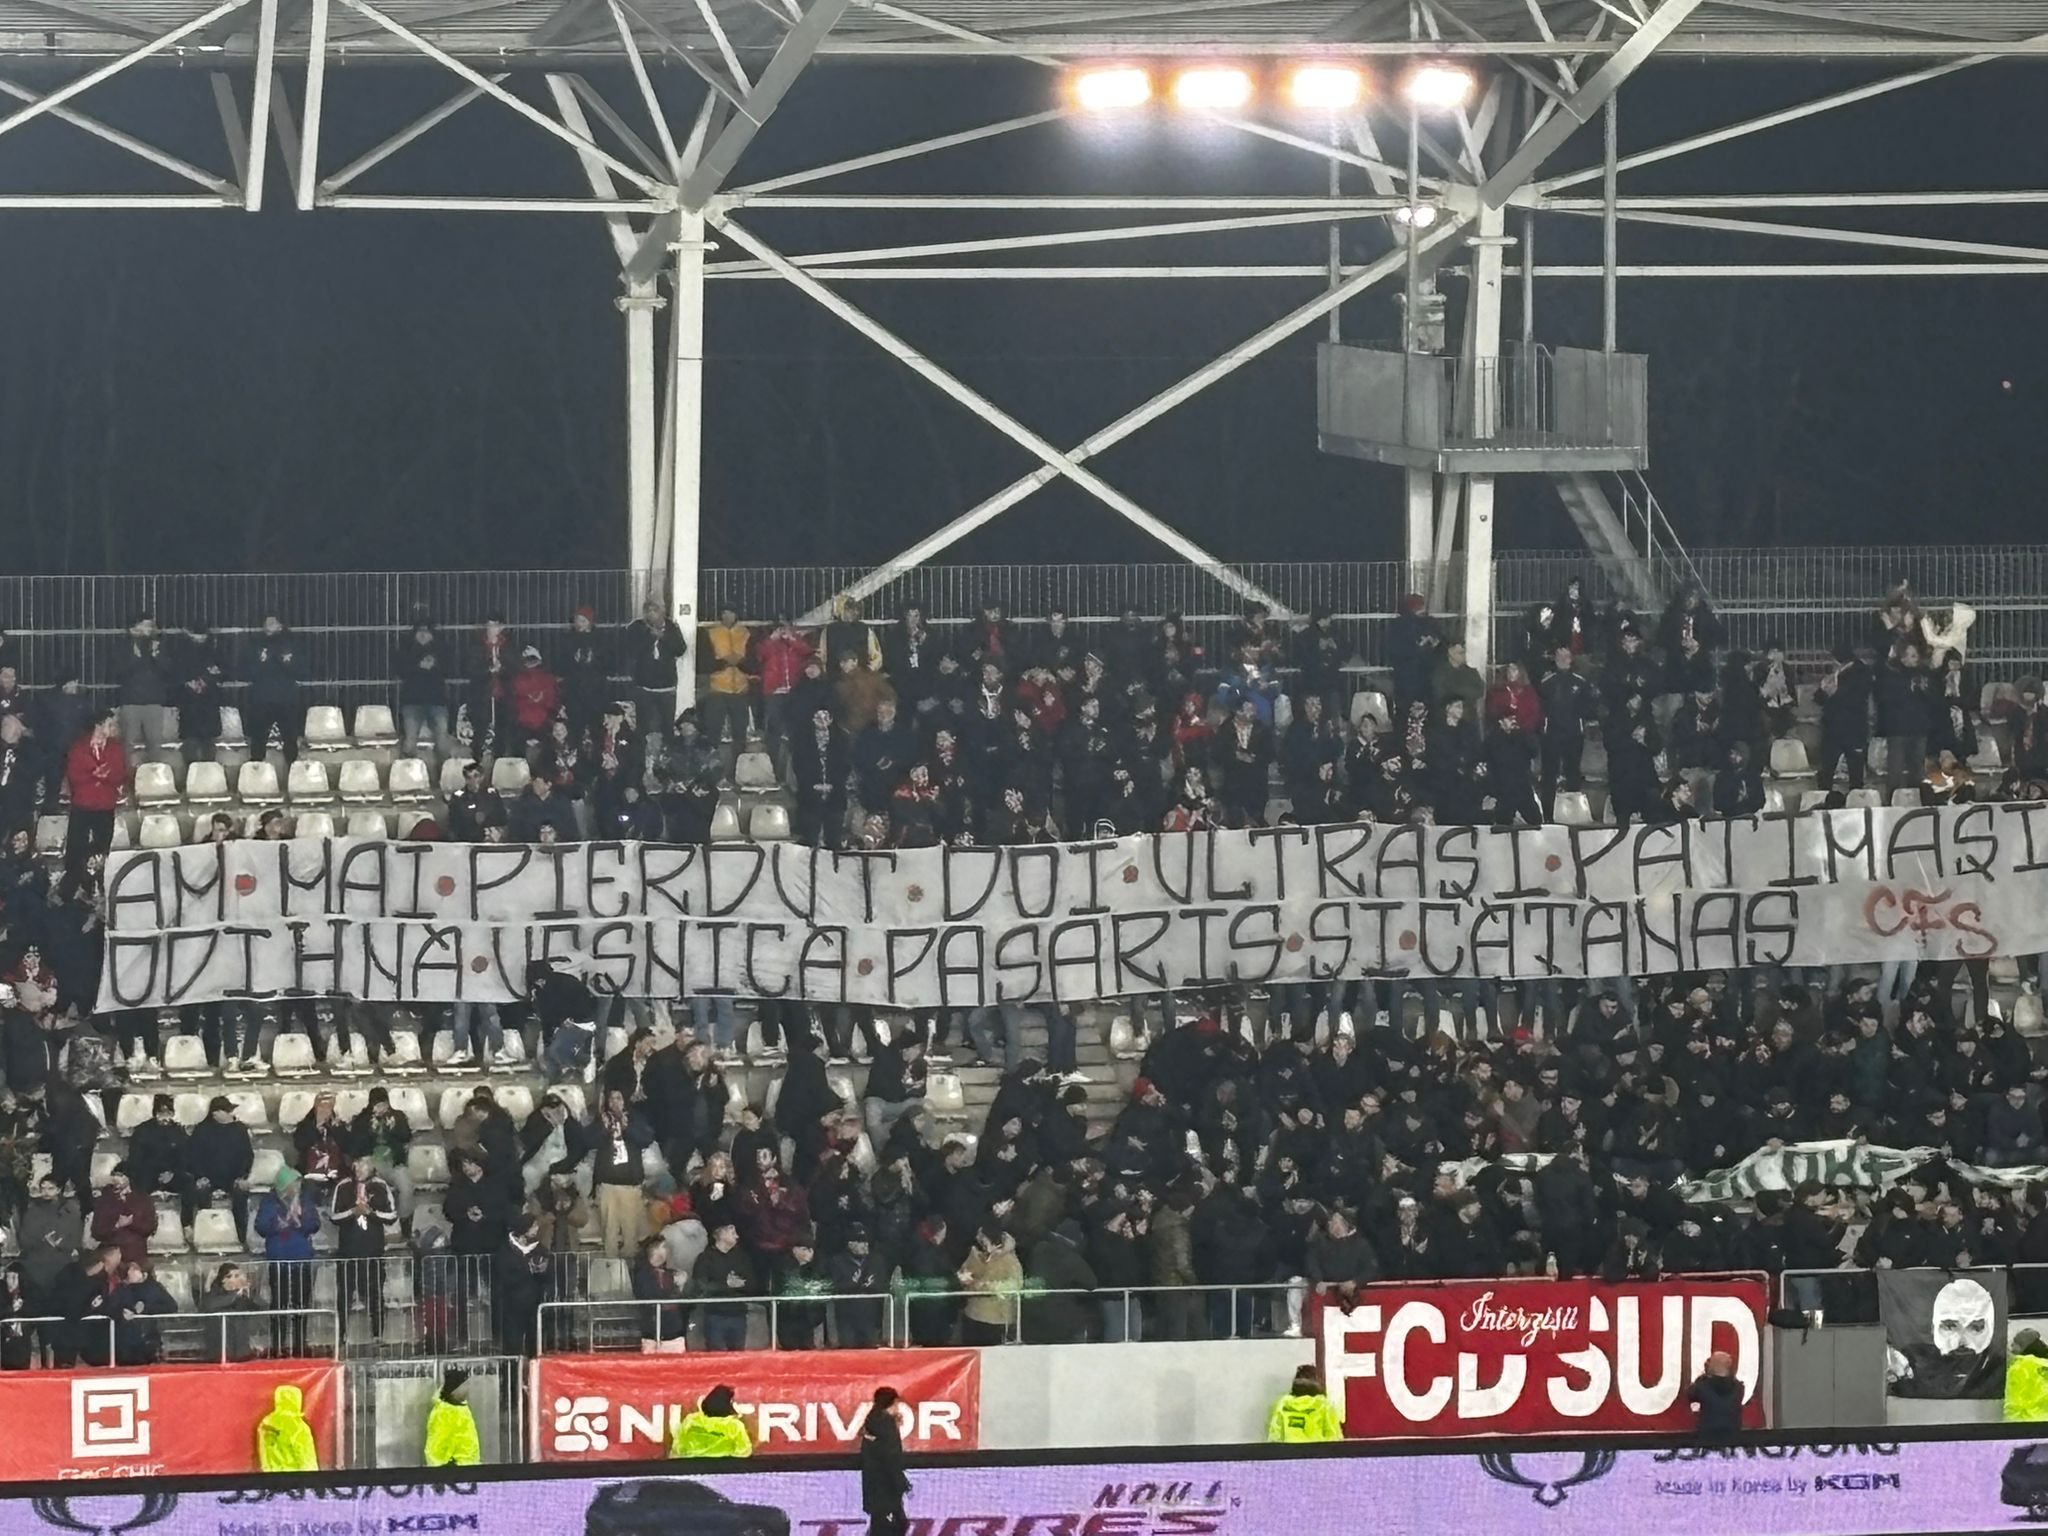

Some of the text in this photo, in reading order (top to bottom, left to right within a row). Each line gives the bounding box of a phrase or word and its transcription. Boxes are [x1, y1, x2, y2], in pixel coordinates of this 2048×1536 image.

[109, 842, 225, 930] AM
[280, 838, 438, 920] MAI
[469, 841, 898, 924] PIERDUT
[943, 843, 1118, 922] DOI
[619, 1401, 962, 1443] NRIVR
